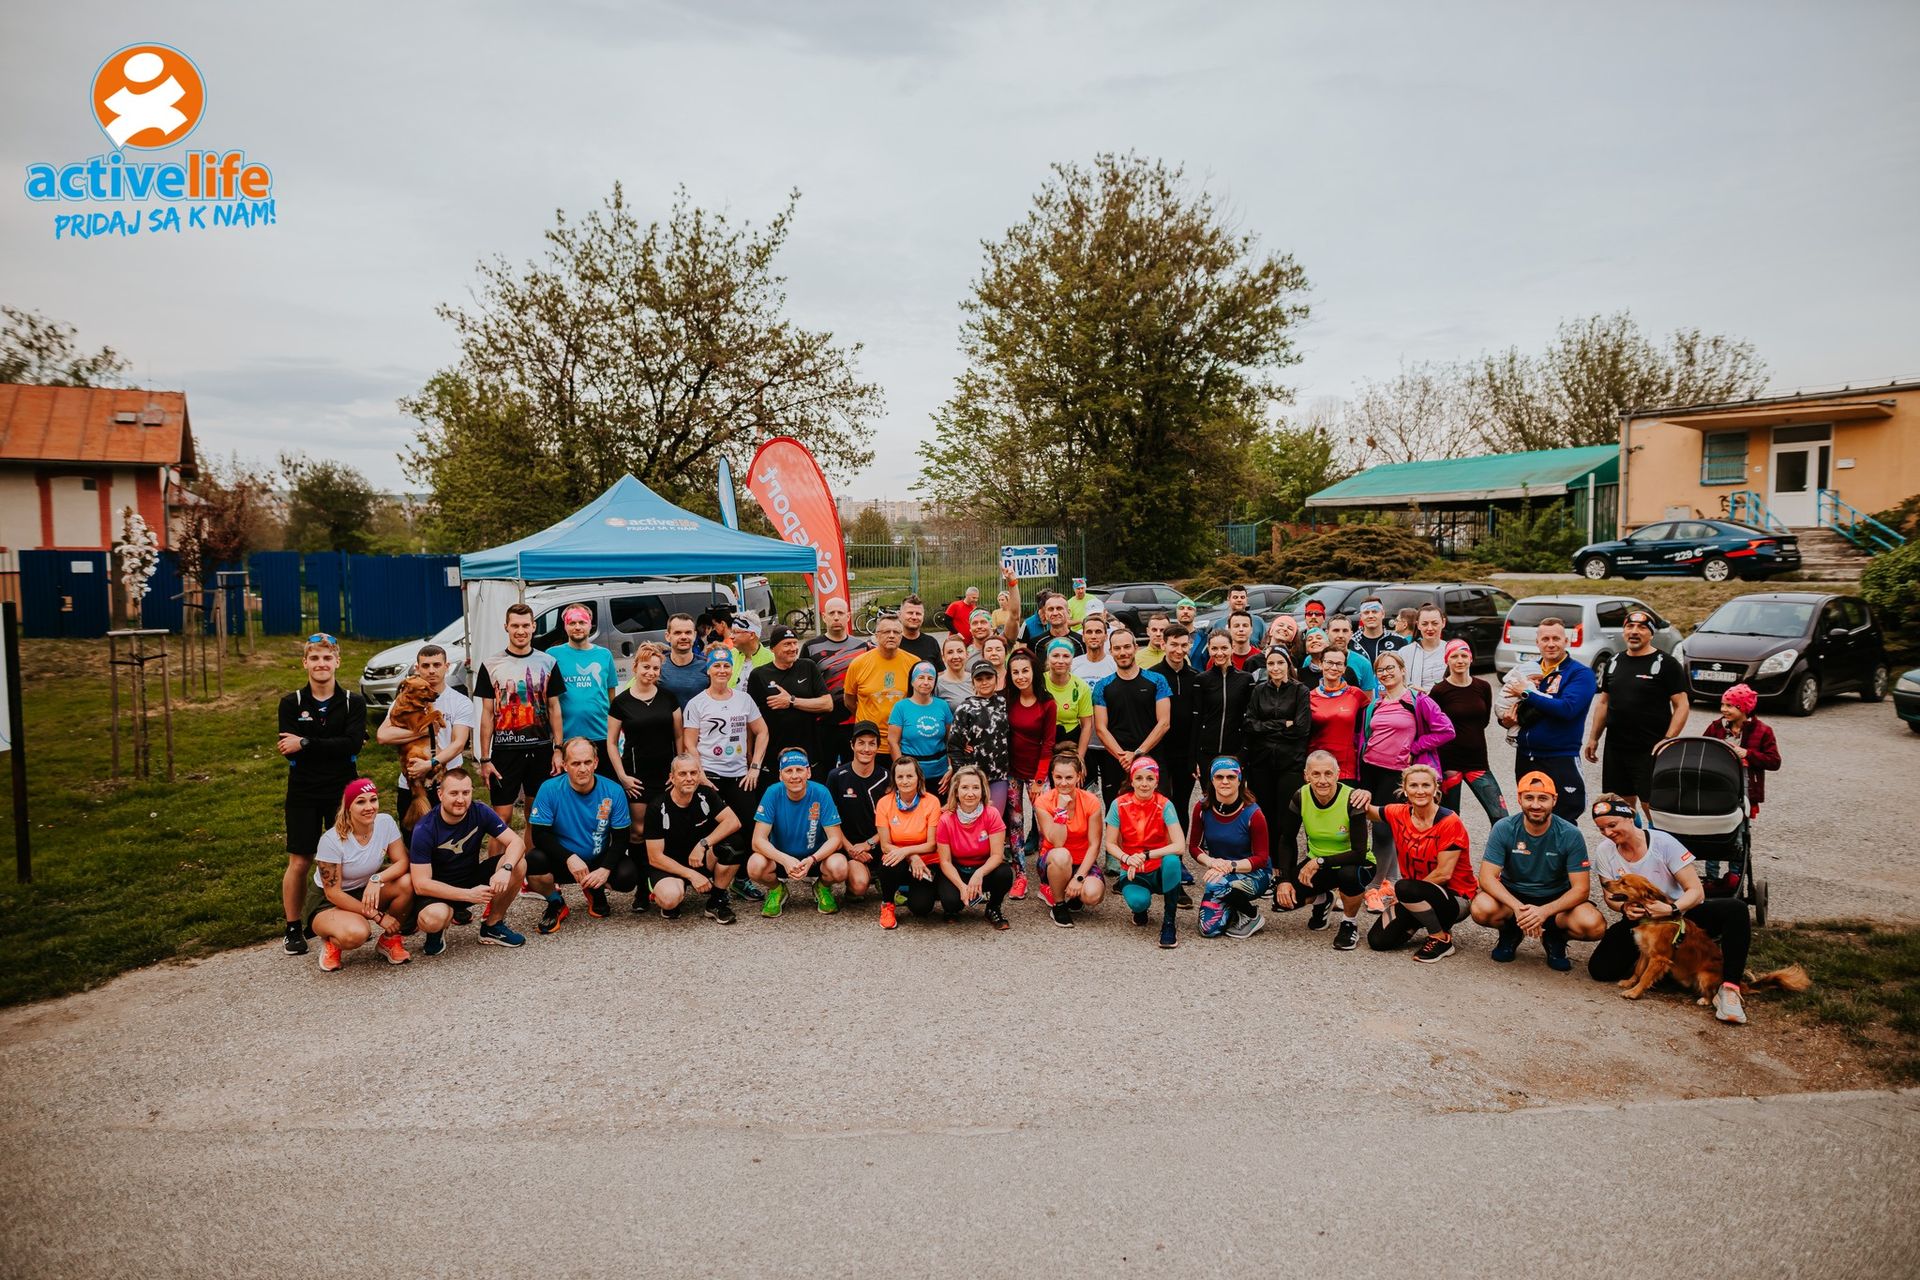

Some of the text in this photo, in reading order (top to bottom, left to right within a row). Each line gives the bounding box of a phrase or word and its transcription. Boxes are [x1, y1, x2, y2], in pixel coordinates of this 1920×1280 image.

[1674, 549, 1693, 561] 229
[592, 797, 613, 856] activelife
[807, 801, 820, 850] activelife
